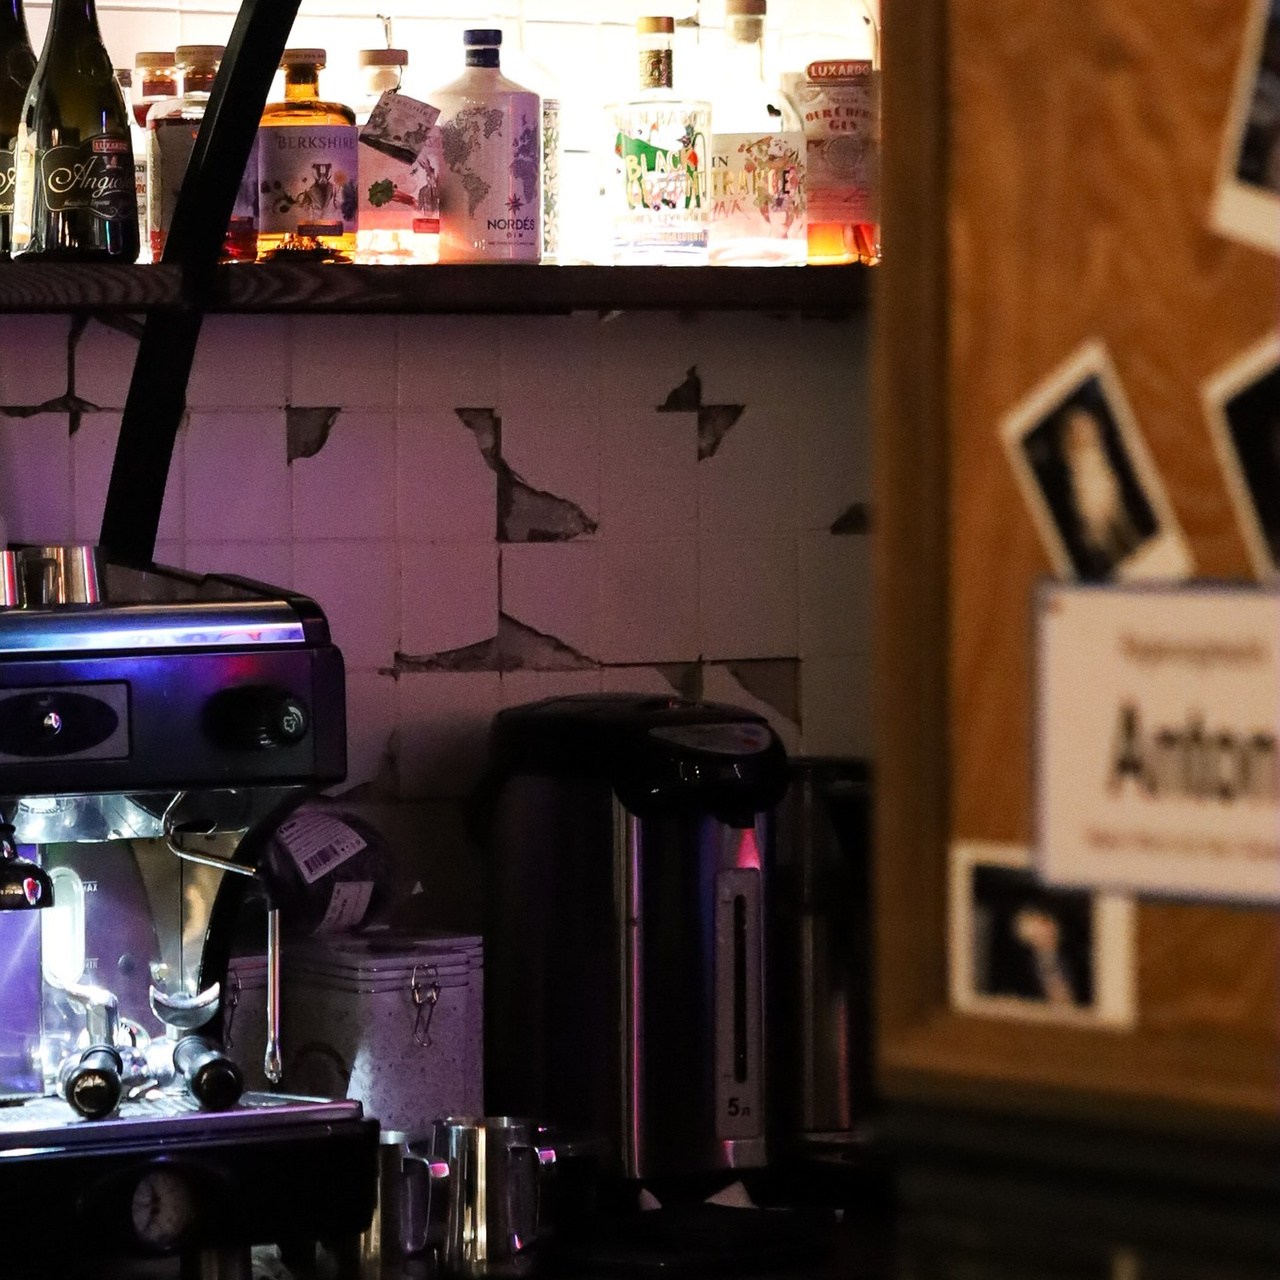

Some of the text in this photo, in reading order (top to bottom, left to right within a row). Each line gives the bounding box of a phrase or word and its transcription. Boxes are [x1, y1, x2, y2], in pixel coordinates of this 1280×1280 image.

[810, 64, 870, 78] LUXARDO
[277, 135, 355, 150] BERKSHIRE
[487, 217, 535, 231] NORDÉS
